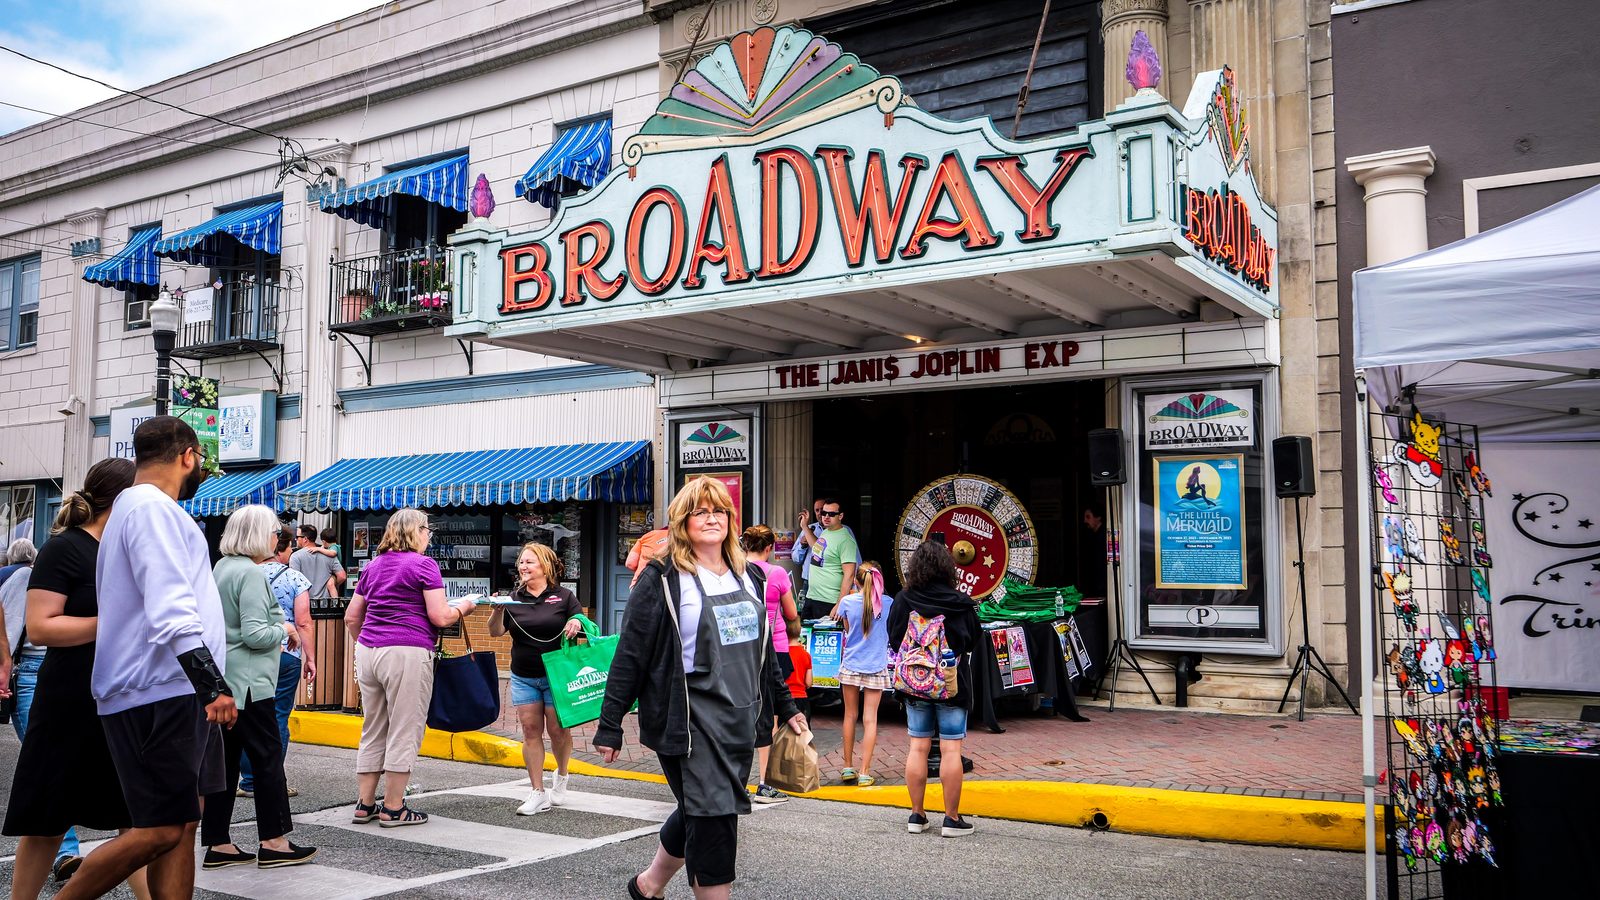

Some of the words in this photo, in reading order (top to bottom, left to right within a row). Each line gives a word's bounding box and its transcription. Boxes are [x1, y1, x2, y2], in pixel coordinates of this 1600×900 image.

[498, 144, 1095, 315] BROADWAY
[1184, 183, 1277, 293] BROADWAY
[775, 364, 820, 389] THE
[830, 356, 900, 385] JANIS
[910, 347, 1001, 378] JOPLIN
[1024, 340, 1080, 370] EXP
[195, 429, 216, 437] tman
[1149, 422, 1248, 440] BROADWAY
[1154, 436, 1244, 445] THEATRE
[682, 446, 746, 460] BROADWAY
[952, 512, 995, 534] BROADWAY
[1180, 512, 1195, 520] THE
[1196, 512, 1220, 520] LITTLE
[1166, 516, 1232, 533] MERMAID
[440, 535, 465, 545] CITIZEN
[465, 535, 492, 545] DISCOUNT
[458, 548, 484, 559] PRESSURE
[456, 560, 476, 571] DAILY
[965, 572, 980, 586] OF
[448, 581, 488, 598] Wheelchairs
[1196, 608, 1210, 625] P
[814, 646, 838, 655] FISH
